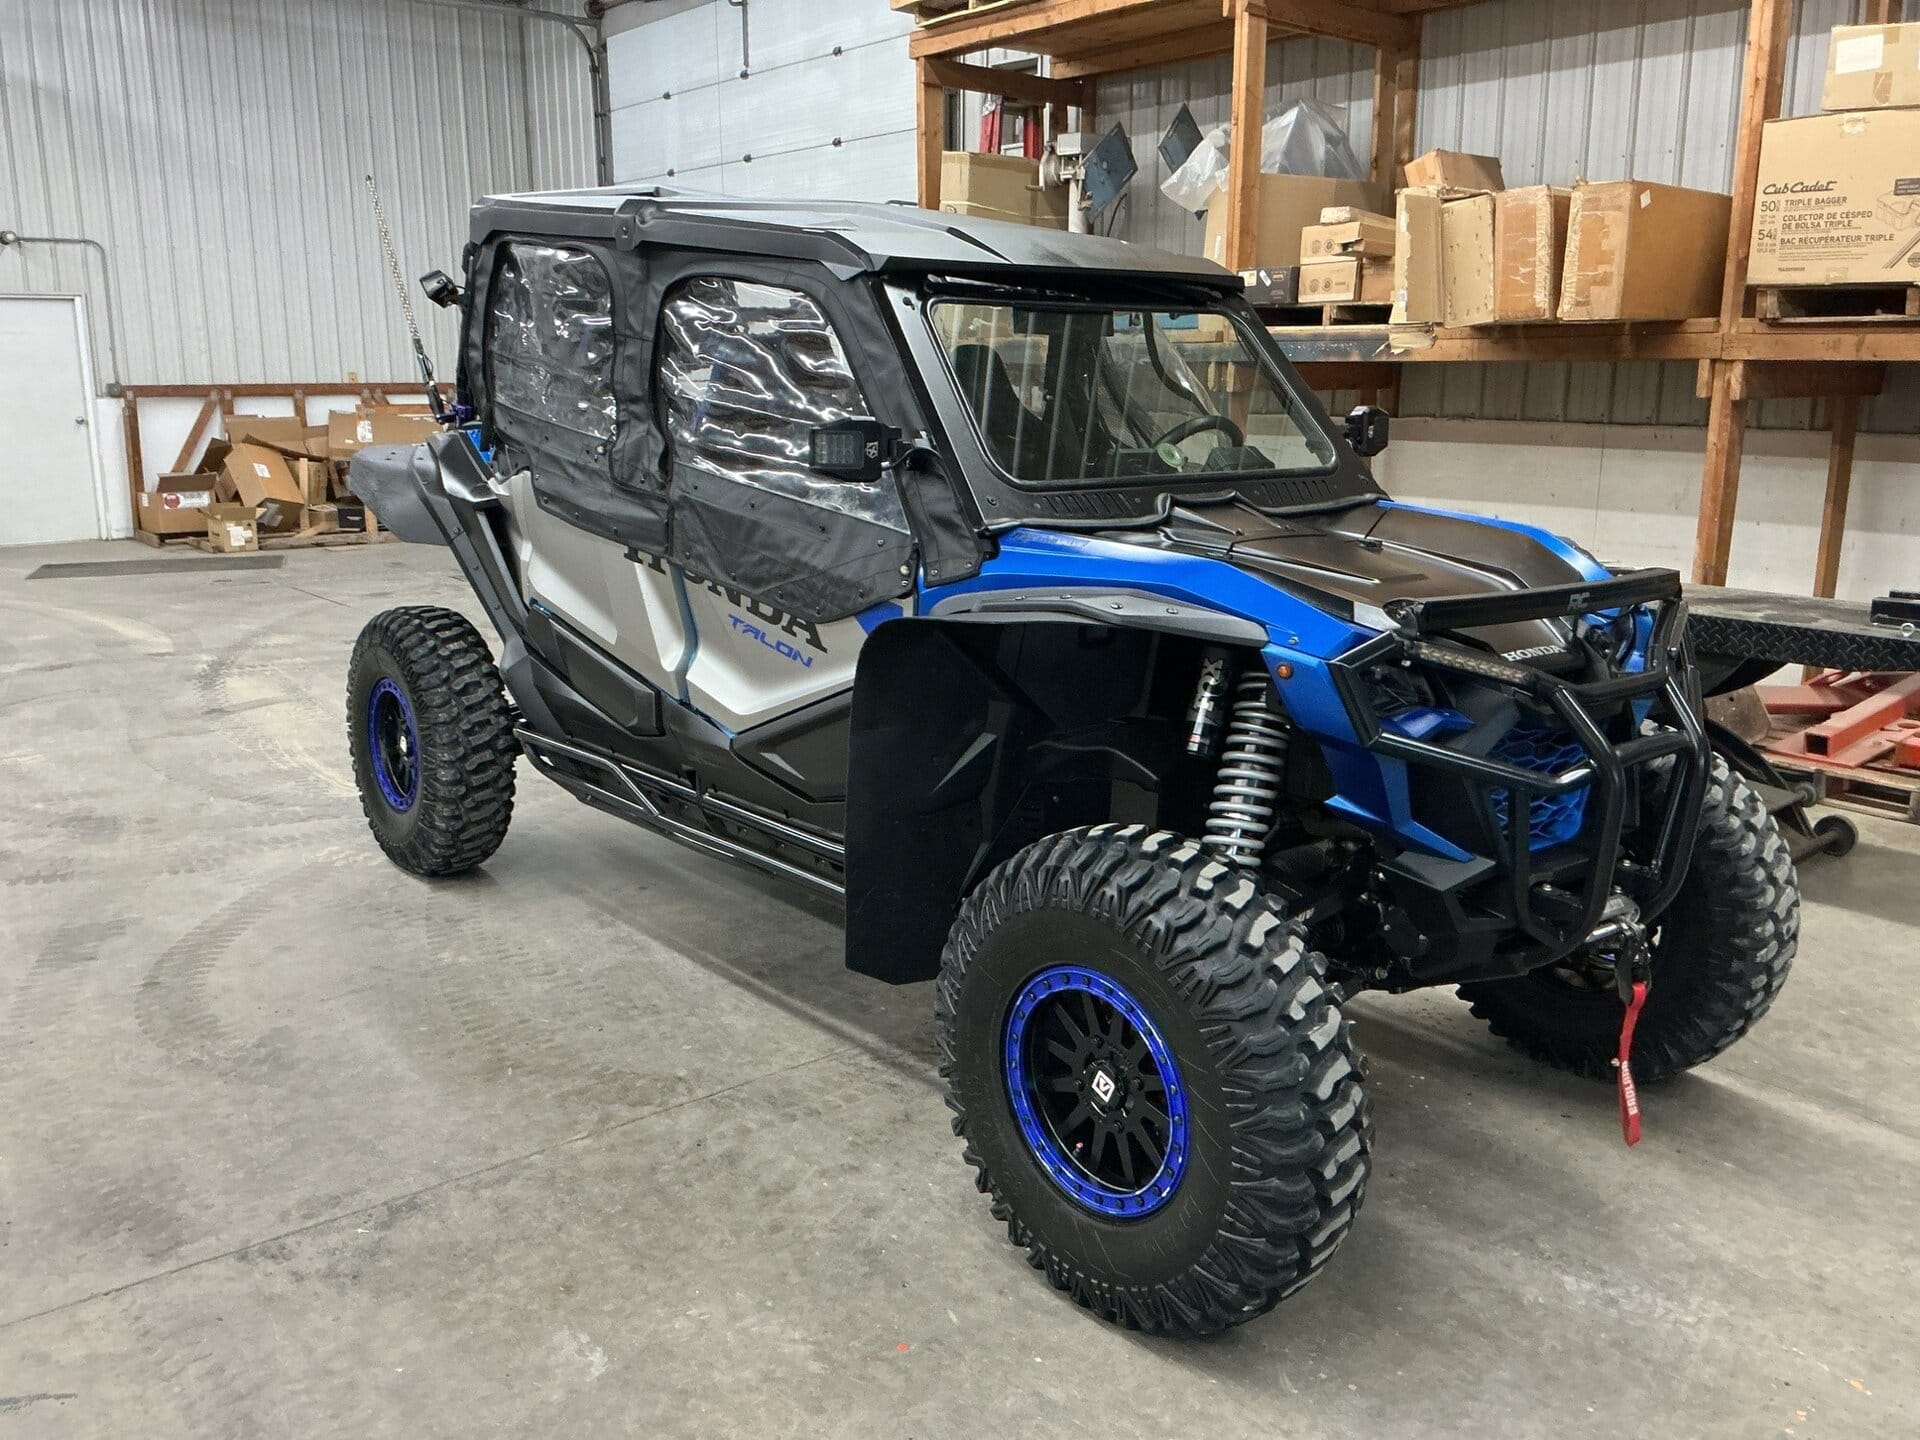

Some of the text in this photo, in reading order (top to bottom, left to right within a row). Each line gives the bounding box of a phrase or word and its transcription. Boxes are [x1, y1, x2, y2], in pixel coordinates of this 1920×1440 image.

[1763, 180, 1838, 195] Cub Cadet
[1760, 200, 1776, 212] 50
[1785, 198, 1813, 207] TRIPLE
[1815, 196, 1848, 205] BAGGER
[1782, 213, 1824, 222] COLECTOR
[1826, 212, 1838, 220] DE
[1794, 221, 1821, 229] BOLSA
[1824, 219, 1853, 228] TRIPLE
[1757, 229, 1773, 241] 54
[1780, 237, 1796, 245] BAC
[1865, 233, 1895, 242] TRIPLE
[728, 613, 814, 669] TALON
[1500, 645, 1566, 661] HONDA
